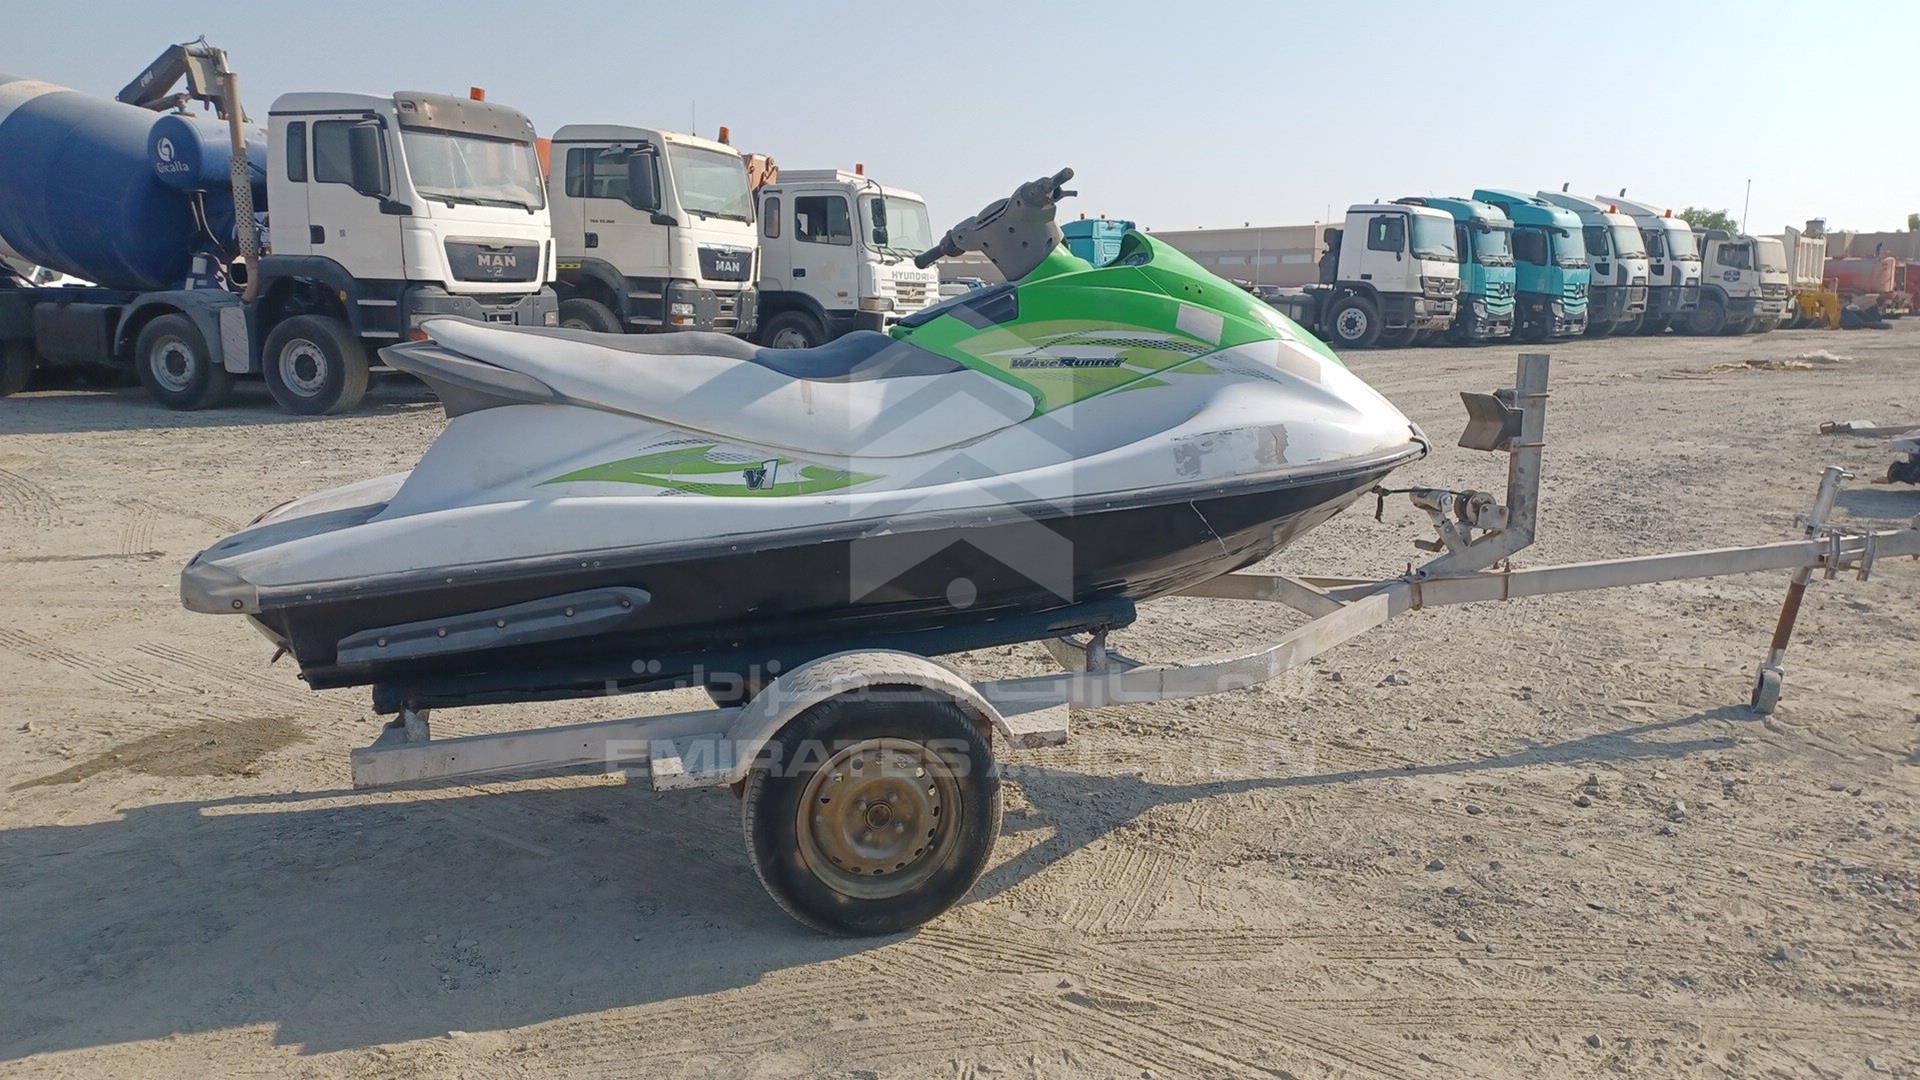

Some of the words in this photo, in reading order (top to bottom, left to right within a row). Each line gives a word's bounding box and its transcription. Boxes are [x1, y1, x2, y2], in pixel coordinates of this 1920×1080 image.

[477, 254, 517, 268] MAN
[715, 260, 740, 273] MAN
[891, 270, 930, 281] HYUNDAI
[1009, 356, 1128, 369] WaveRunner
